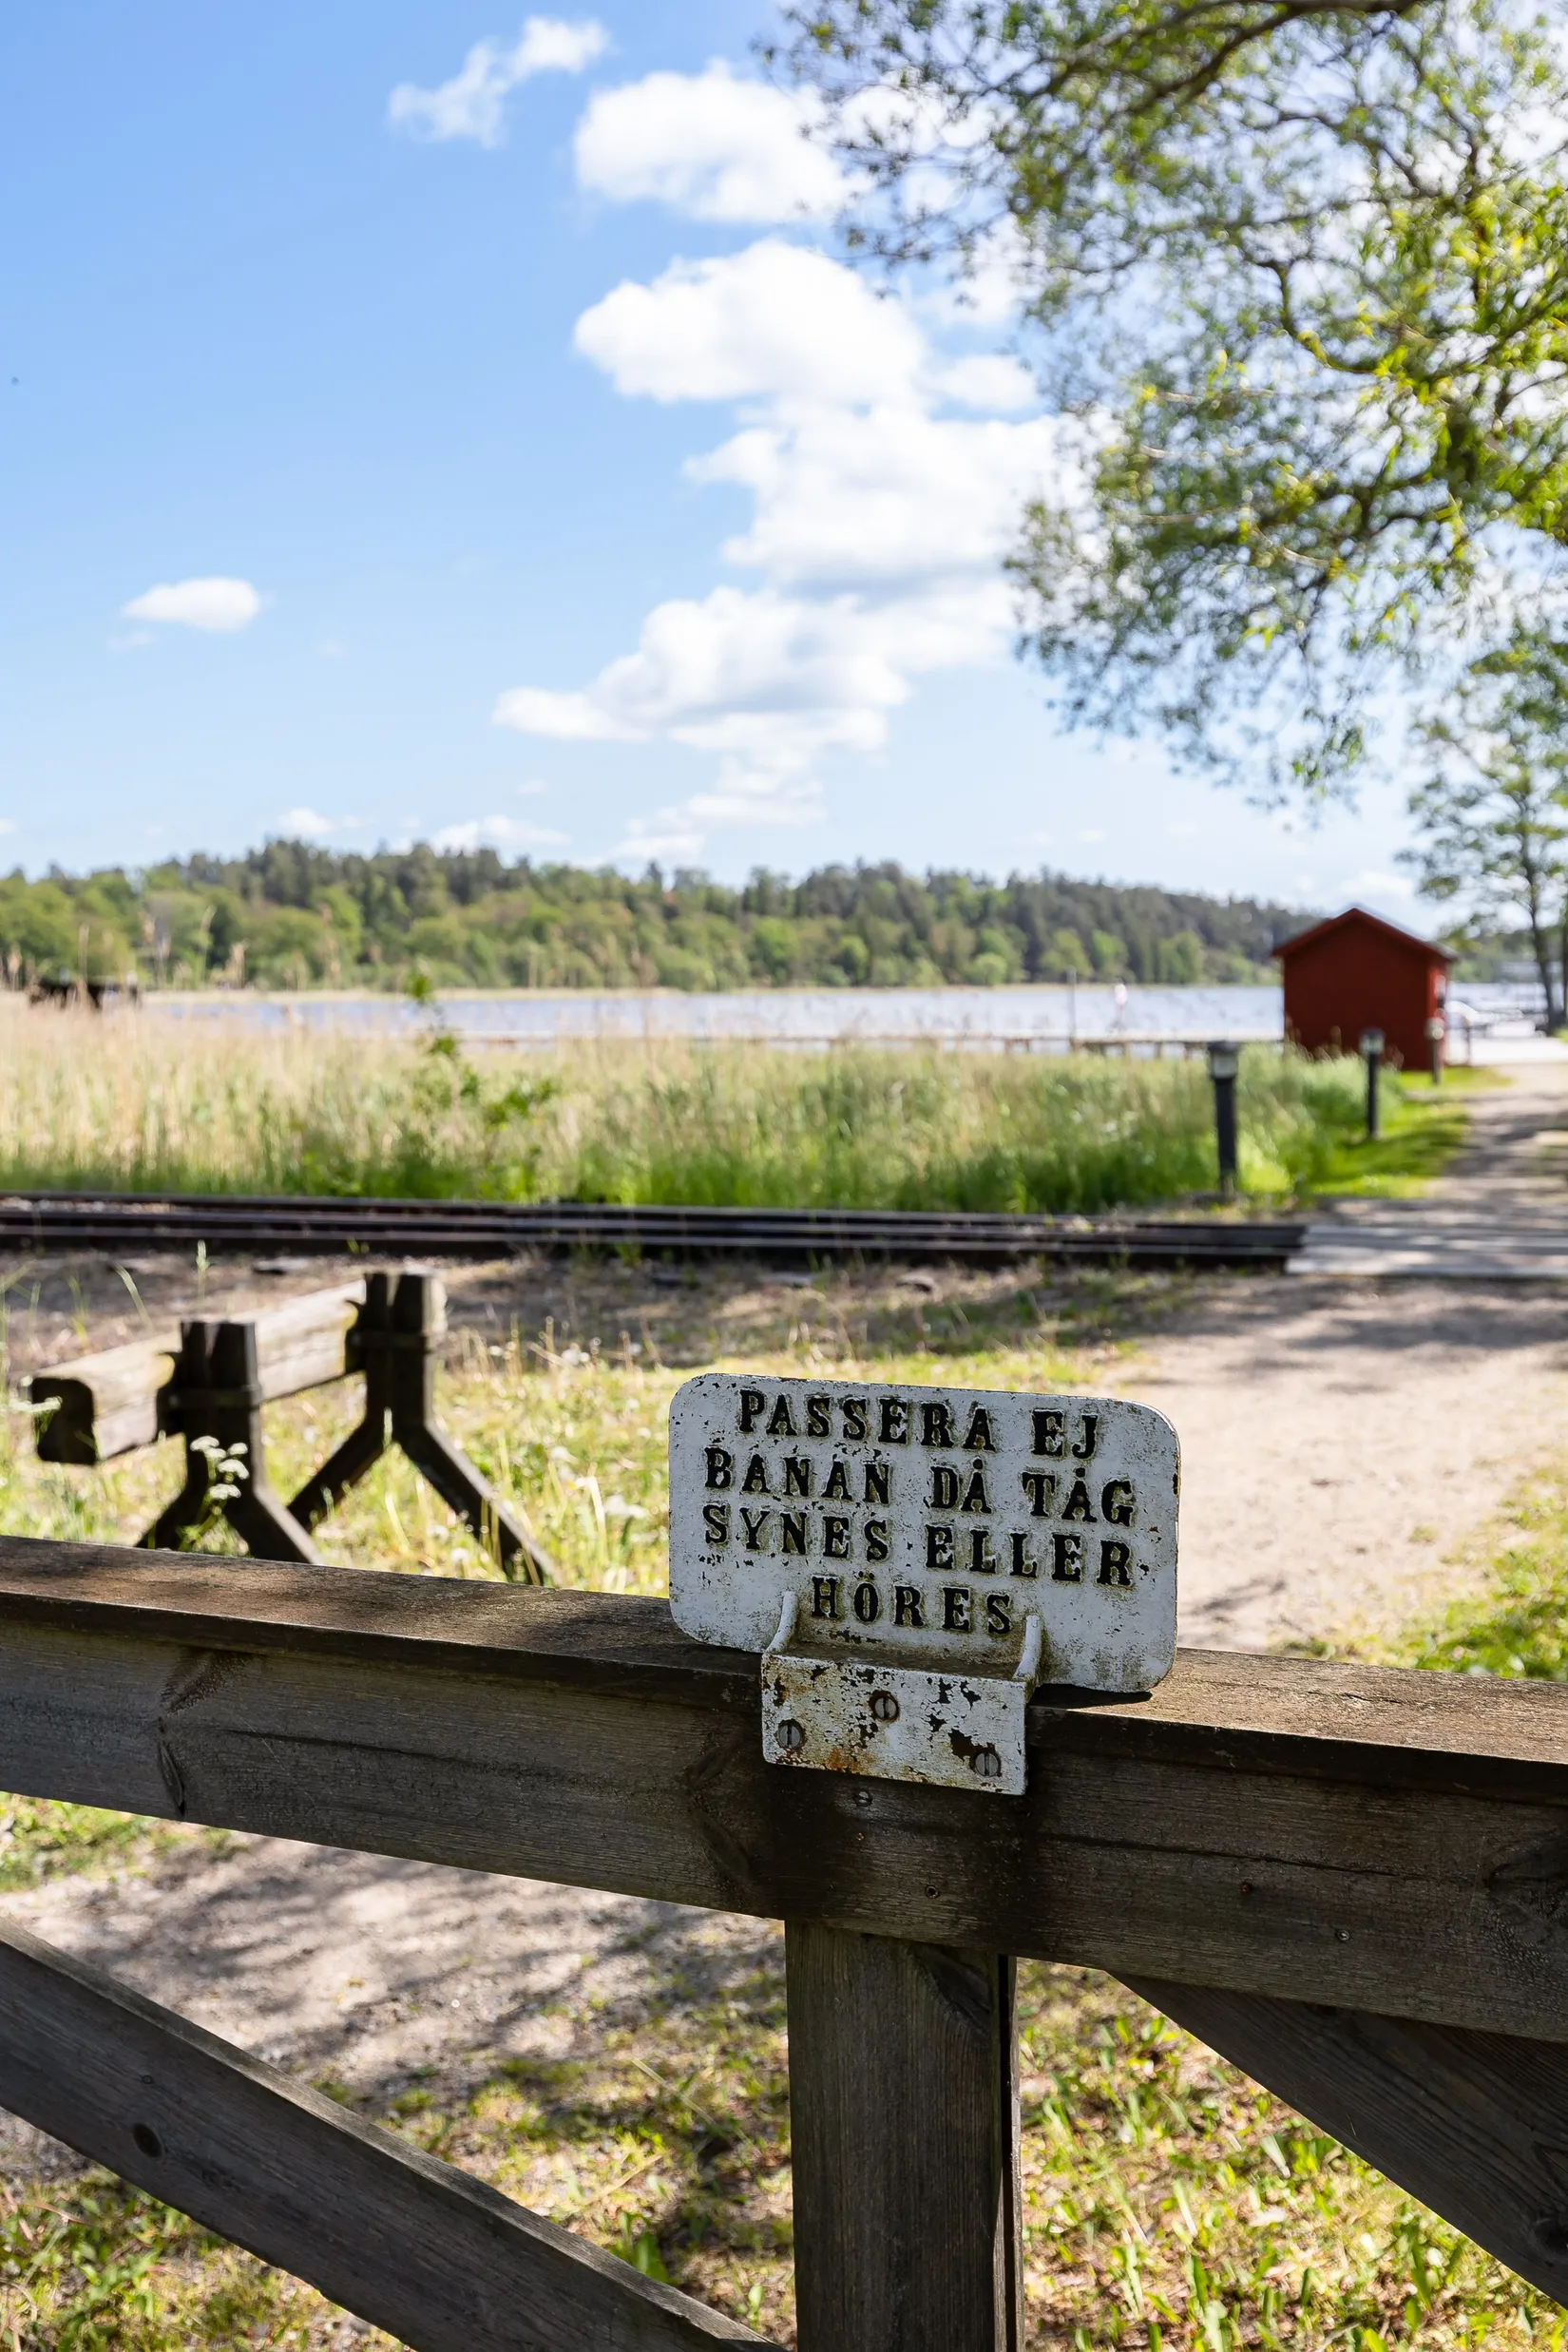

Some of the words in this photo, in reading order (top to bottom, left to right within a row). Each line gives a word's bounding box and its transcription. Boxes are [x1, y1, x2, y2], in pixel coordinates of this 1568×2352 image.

[739, 1389, 996, 1452] PASSERA
[1031, 1408, 1098, 1460] EJ
[704, 1446, 890, 1505] BANAN
[930, 1459, 992, 1514] DÅ
[1022, 1468, 1134, 1526] TÅG
[701, 1504, 889, 1561] SYNES
[926, 1524, 1133, 1586] ELLER
[811, 1572, 1010, 1635] HÖRES
